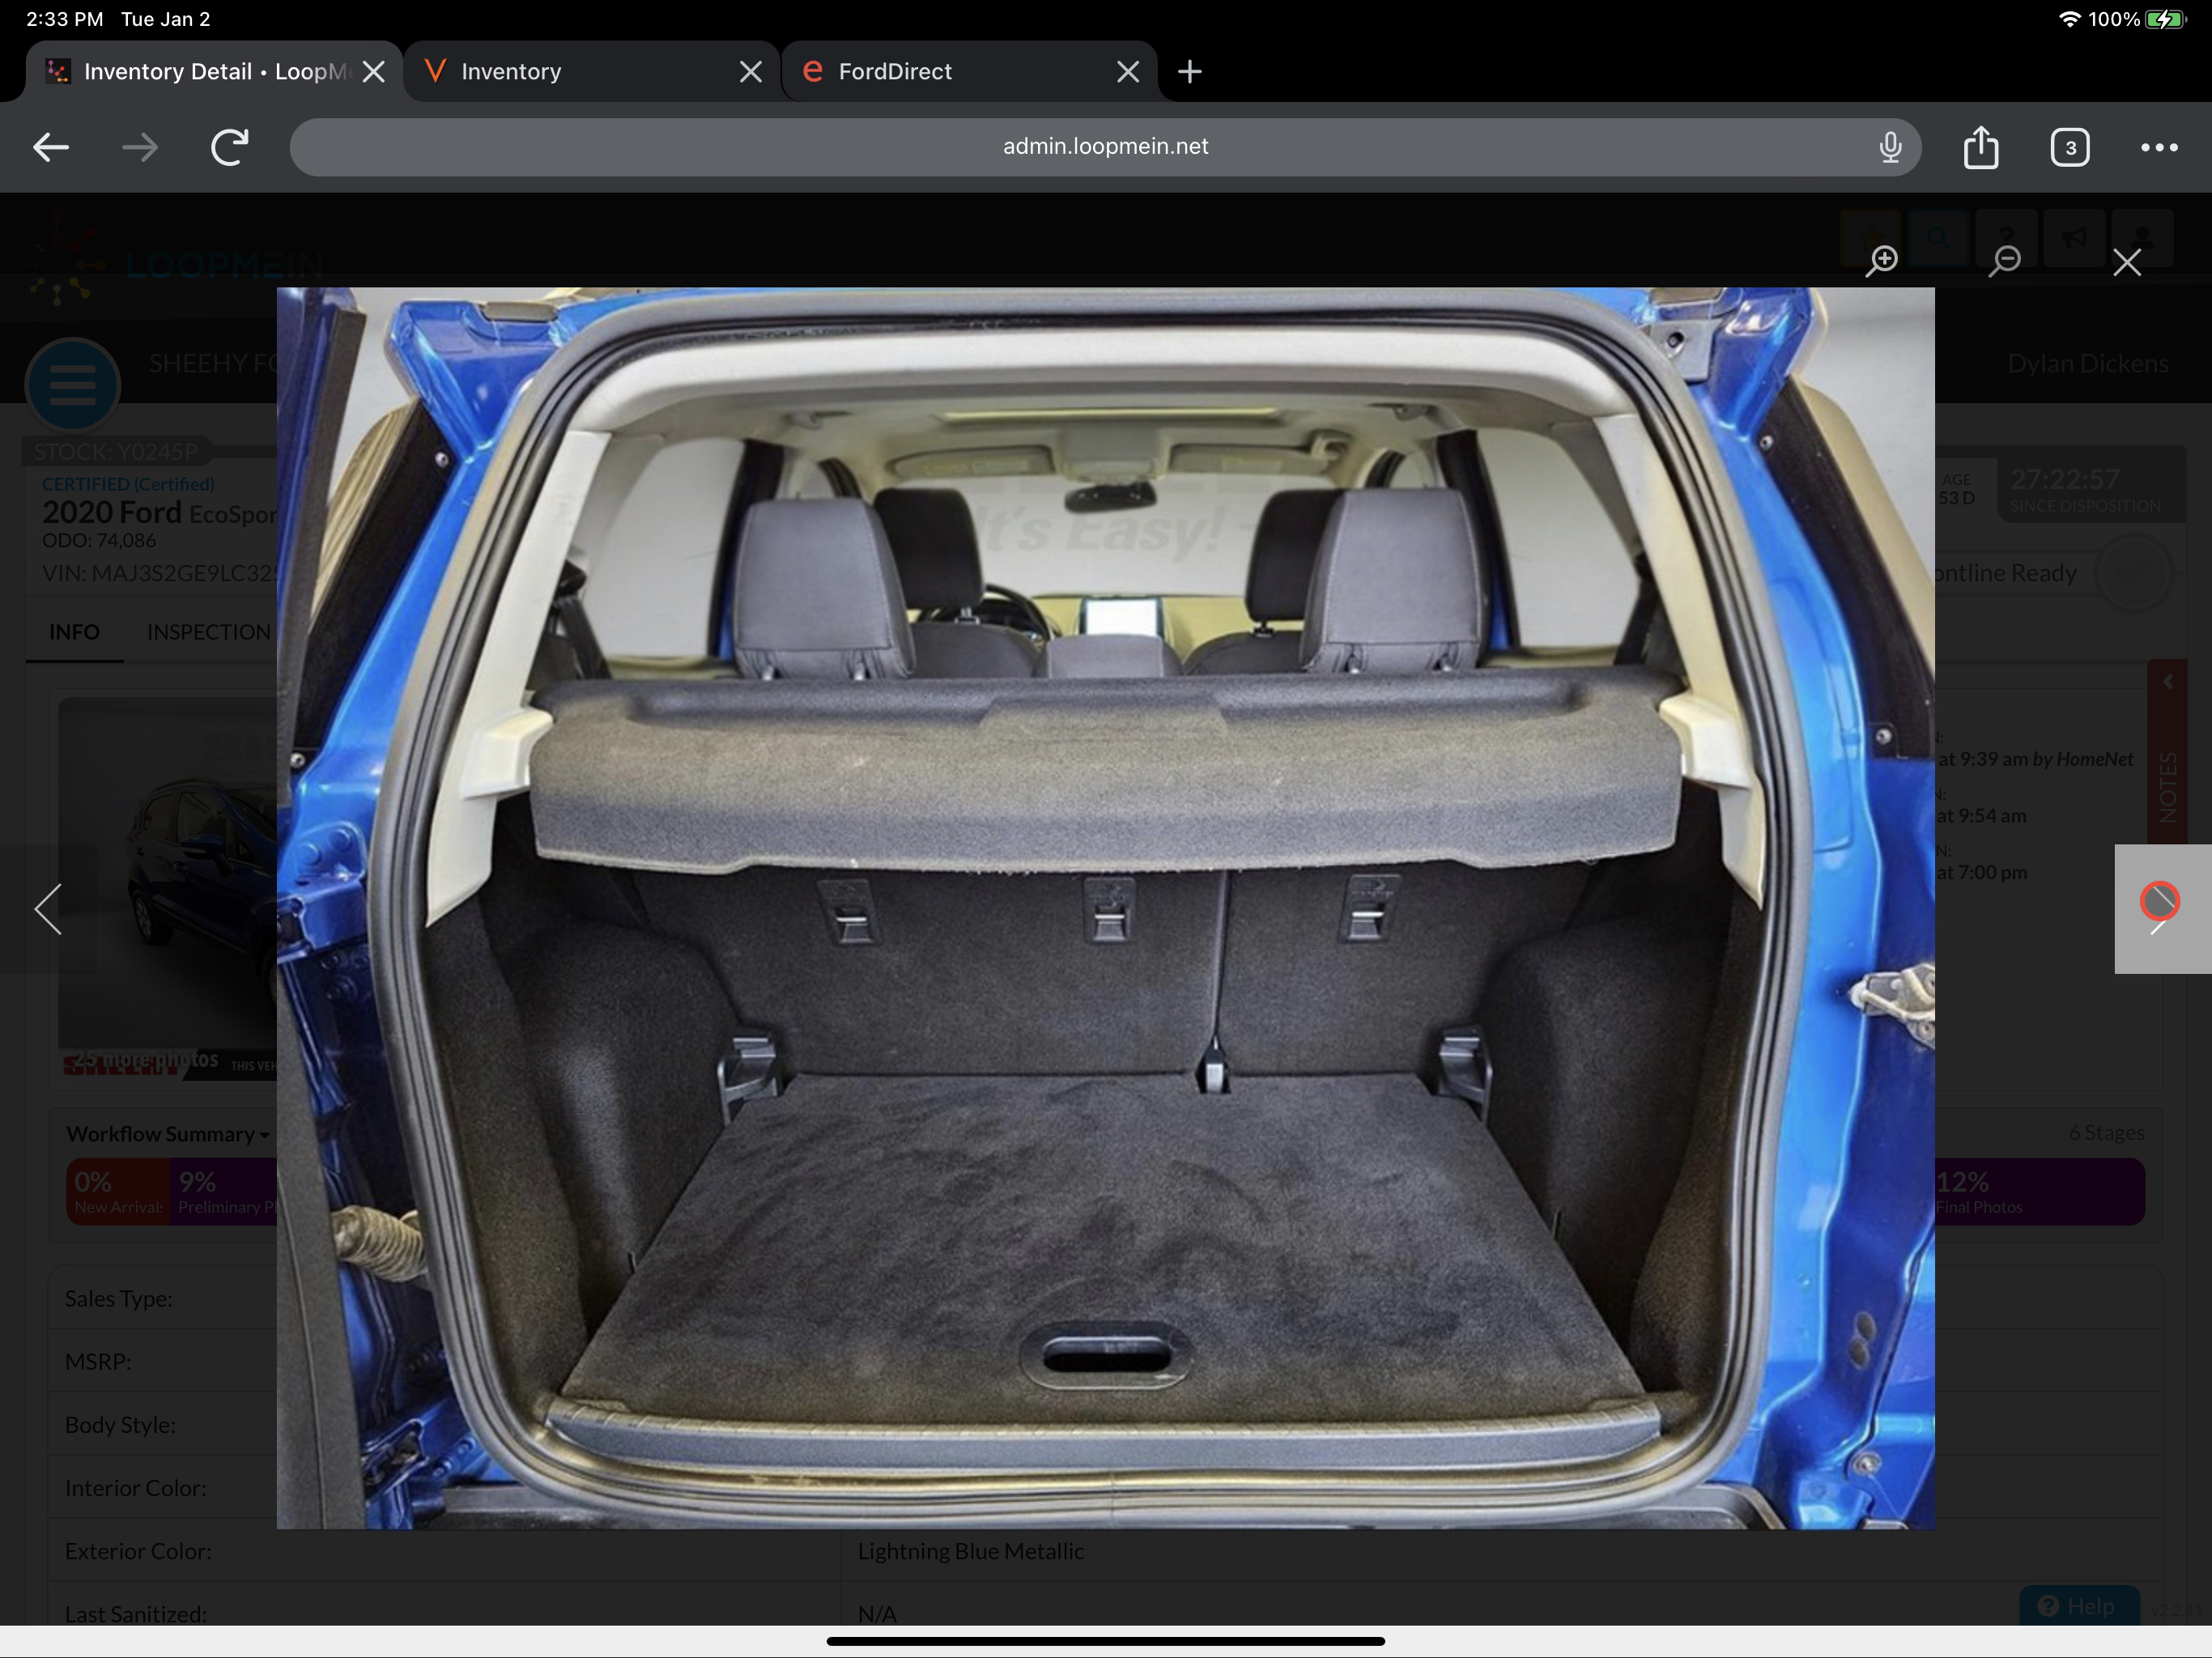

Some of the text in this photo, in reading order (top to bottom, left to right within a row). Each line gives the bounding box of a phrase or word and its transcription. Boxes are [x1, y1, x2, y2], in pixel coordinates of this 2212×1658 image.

[27, 11, 103, 27] 2:33 PM
[121, 12, 210, 27] Tue Jan 2
[2089, 11, 2140, 27] 100%
[86, 63, 184, 83] Inventory
[193, 62, 251, 79] Detail
[463, 63, 561, 83] Inventory
[840, 62, 952, 79] FordDirect
[1004, 137, 1209, 158] admin.loopmein.net
[2066, 141, 2077, 155] 3
[127, 252, 322, 278] LOOPMEIN
[150, 354, 248, 372] SHEEHY
[2010, 353, 2169, 377] Dylan Dickens
[35, 444, 198, 460] STOCK: Y0245P
[43, 477, 215, 493] CERTIFIED (Certified)
[1942, 474, 1971, 485] AGE
[2011, 469, 2120, 489] 27:22:57
[1939, 491, 1975, 504] 53 D
[2011, 500, 2160, 512] SINCE DISPOSITION
[43, 500, 113, 523] 2020
[121, 500, 181, 523] Ford
[43, 533, 156, 550] ODO: 74,086
[42, 565, 86, 581] VIN:
[2013, 563, 2078, 585] Ready
[51, 624, 100, 640] INFO
[149, 624, 270, 640] INSPECTION
[1939, 751, 2134, 769] at 9:39 am by HomeNet
[2160, 753, 2176, 823] NOTES
[1938, 808, 2027, 823] at 9:54 am
[1938, 865, 2027, 882] at 7:00 pm
[74, 1050, 219, 1073] 25 more photos
[232, 1061, 254, 1071] THIS
[66, 1125, 255, 1146] Workflow Summary
[2069, 1124, 2145, 1144] 6 Stages
[75, 1171, 111, 1192] 0%
[180, 1171, 215, 1192] 9%
[1937, 1171, 1989, 1192] 12%
[75, 1201, 108, 1213] New
[180, 1201, 261, 1216] Preliminary
[1936, 1200, 2023, 1214] Final Photos
[66, 1290, 172, 1311] Sales Type:
[66, 1354, 130, 1370] MSRP:
[66, 1416, 175, 1437] Body Style:
[67, 1479, 206, 1496] Interior Color:
[66, 1542, 211, 1559] Exterior Color:
[860, 1542, 1084, 1563] Lightning Blue Metallic
[66, 1605, 206, 1622] Last Sanitized:
[860, 1605, 897, 1623] N/A
[2069, 1597, 2114, 1618] Help
[2150, 1603, 2204, 1618] v2.2.41
